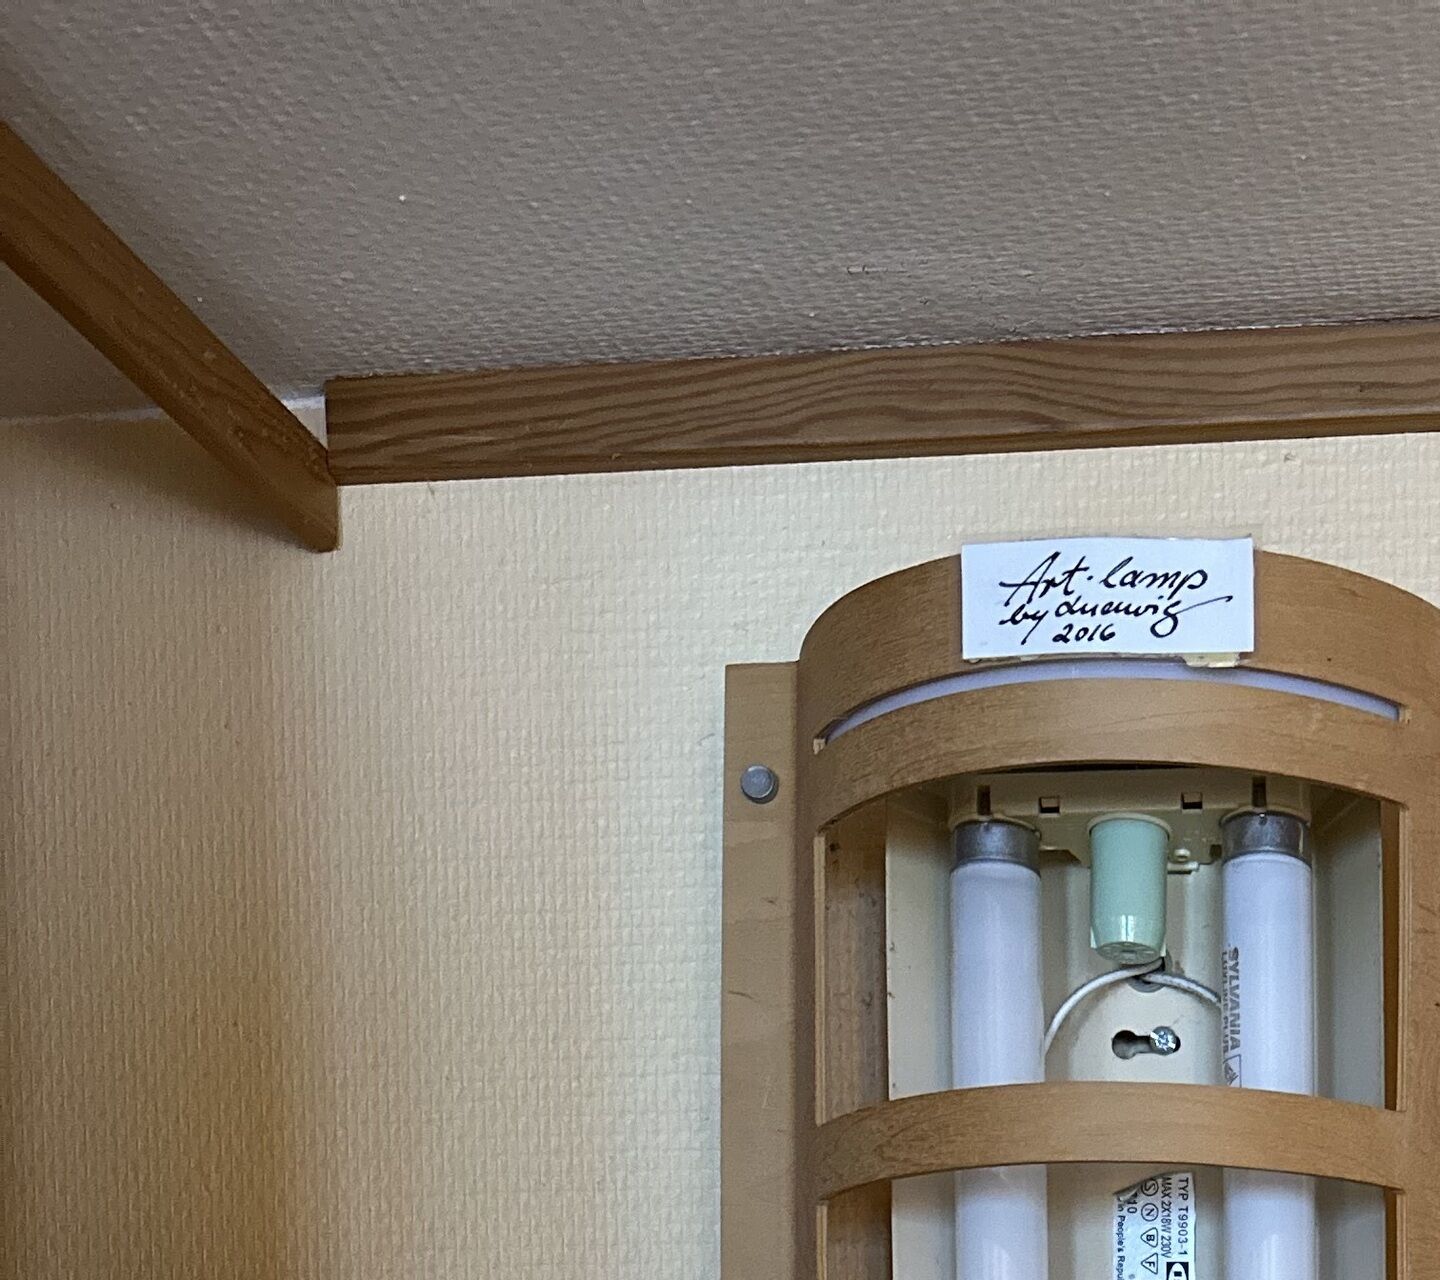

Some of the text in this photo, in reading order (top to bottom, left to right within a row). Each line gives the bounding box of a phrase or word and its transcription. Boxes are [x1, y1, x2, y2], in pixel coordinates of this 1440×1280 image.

[999, 603, 1049, 645] by
[1052, 623, 1115, 643] 2016
[1229, 947, 1240, 1050] SYLVANIA
[1162, 1177, 1172, 1200] MAX
[1116, 1215, 1125, 1253] People's
[1178, 1177, 1188, 1255] TYP T9903-1
[1161, 1235, 1170, 1258] 230V
